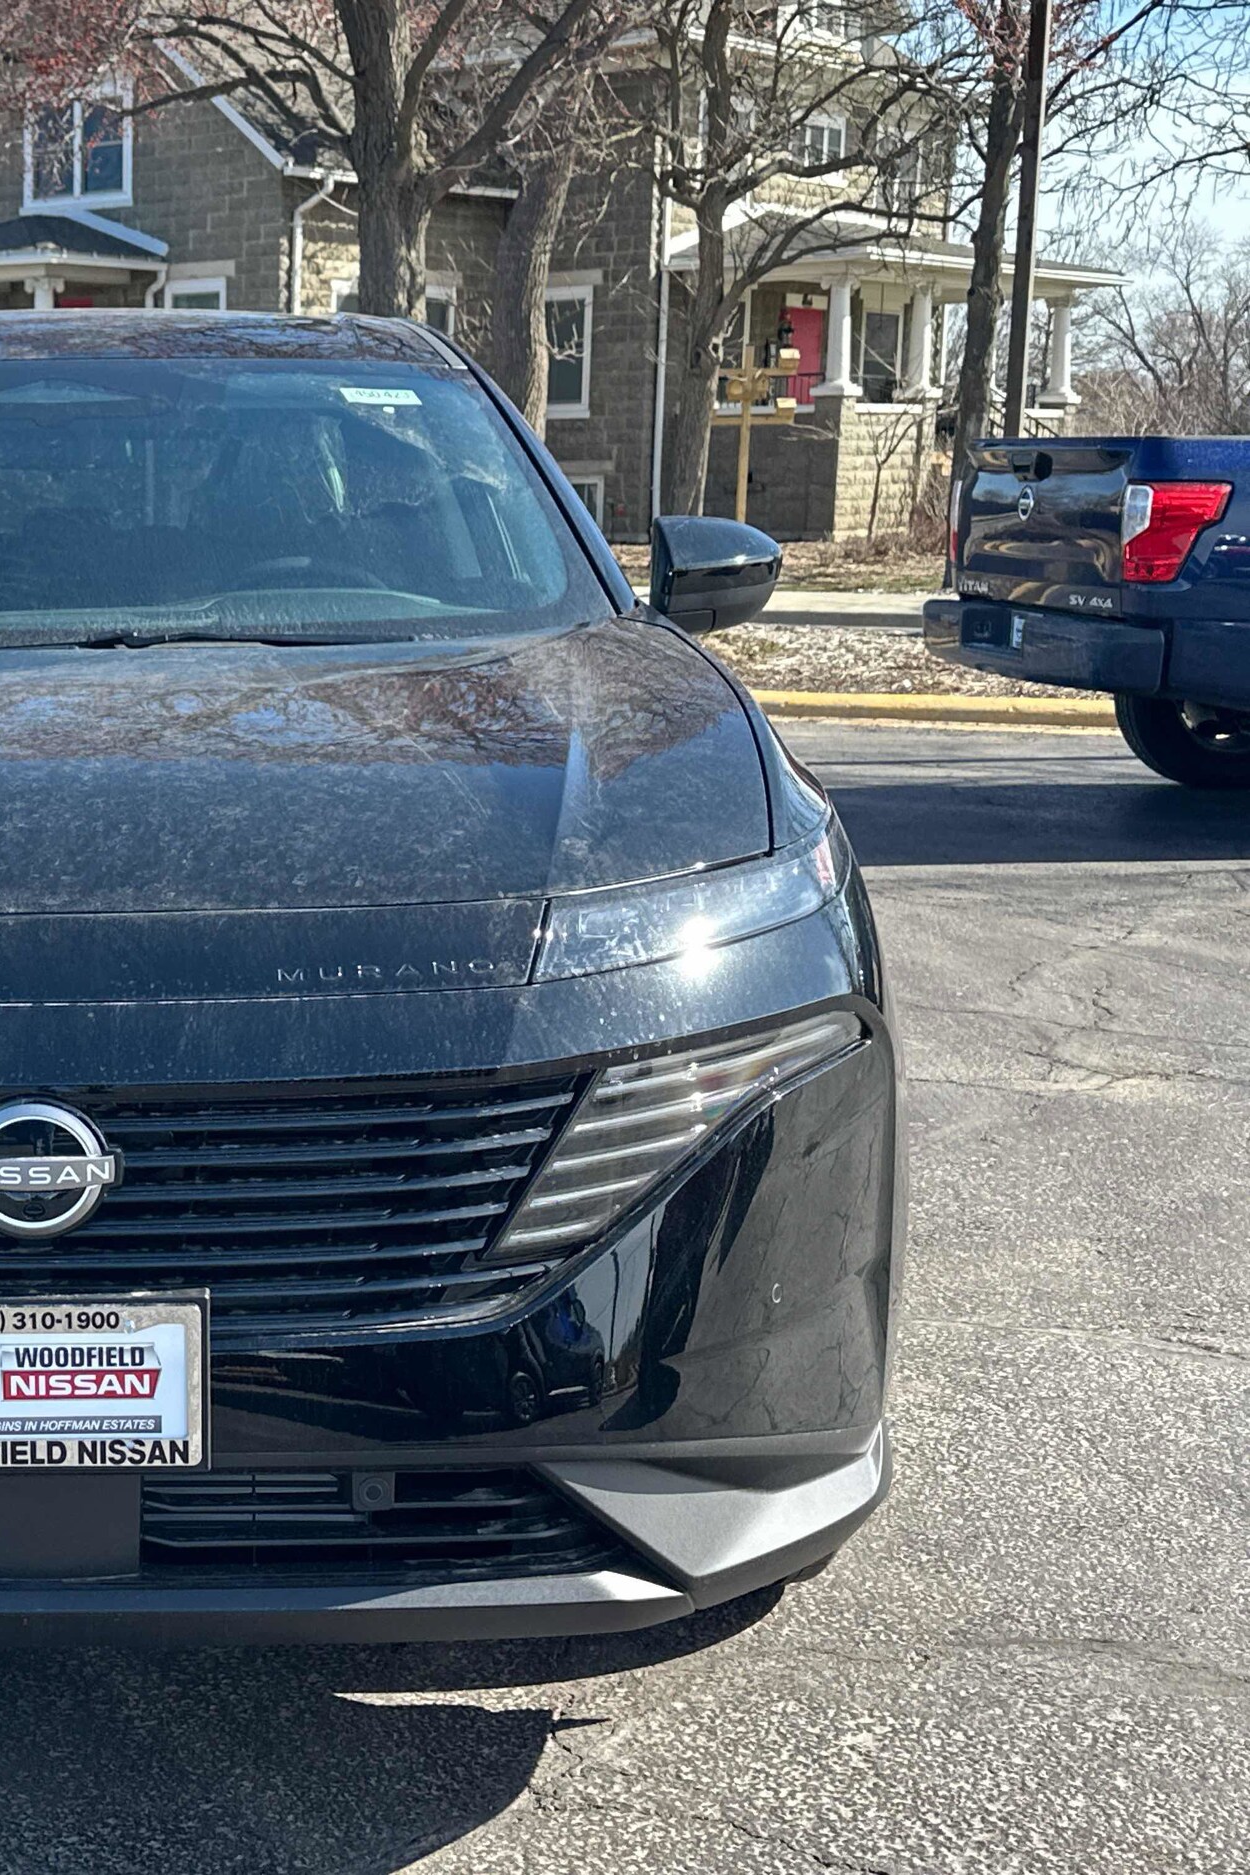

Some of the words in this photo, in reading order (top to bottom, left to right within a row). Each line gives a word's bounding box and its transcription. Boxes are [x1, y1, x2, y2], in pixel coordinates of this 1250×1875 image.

[1068, 594, 1087, 606] SV
[276, 959, 495, 982] MURANO
[12, 1311, 120, 1331] 310-1900
[14, 1346, 145, 1368] WOODFIELD
[9, 1373, 151, 1397] NISSAN
[24, 1420, 37, 1432] IN
[39, 1419, 101, 1431] HOFFMAN
[102, 1418, 155, 1431] ESTATES
[78, 1439, 190, 1465] NISSAN
